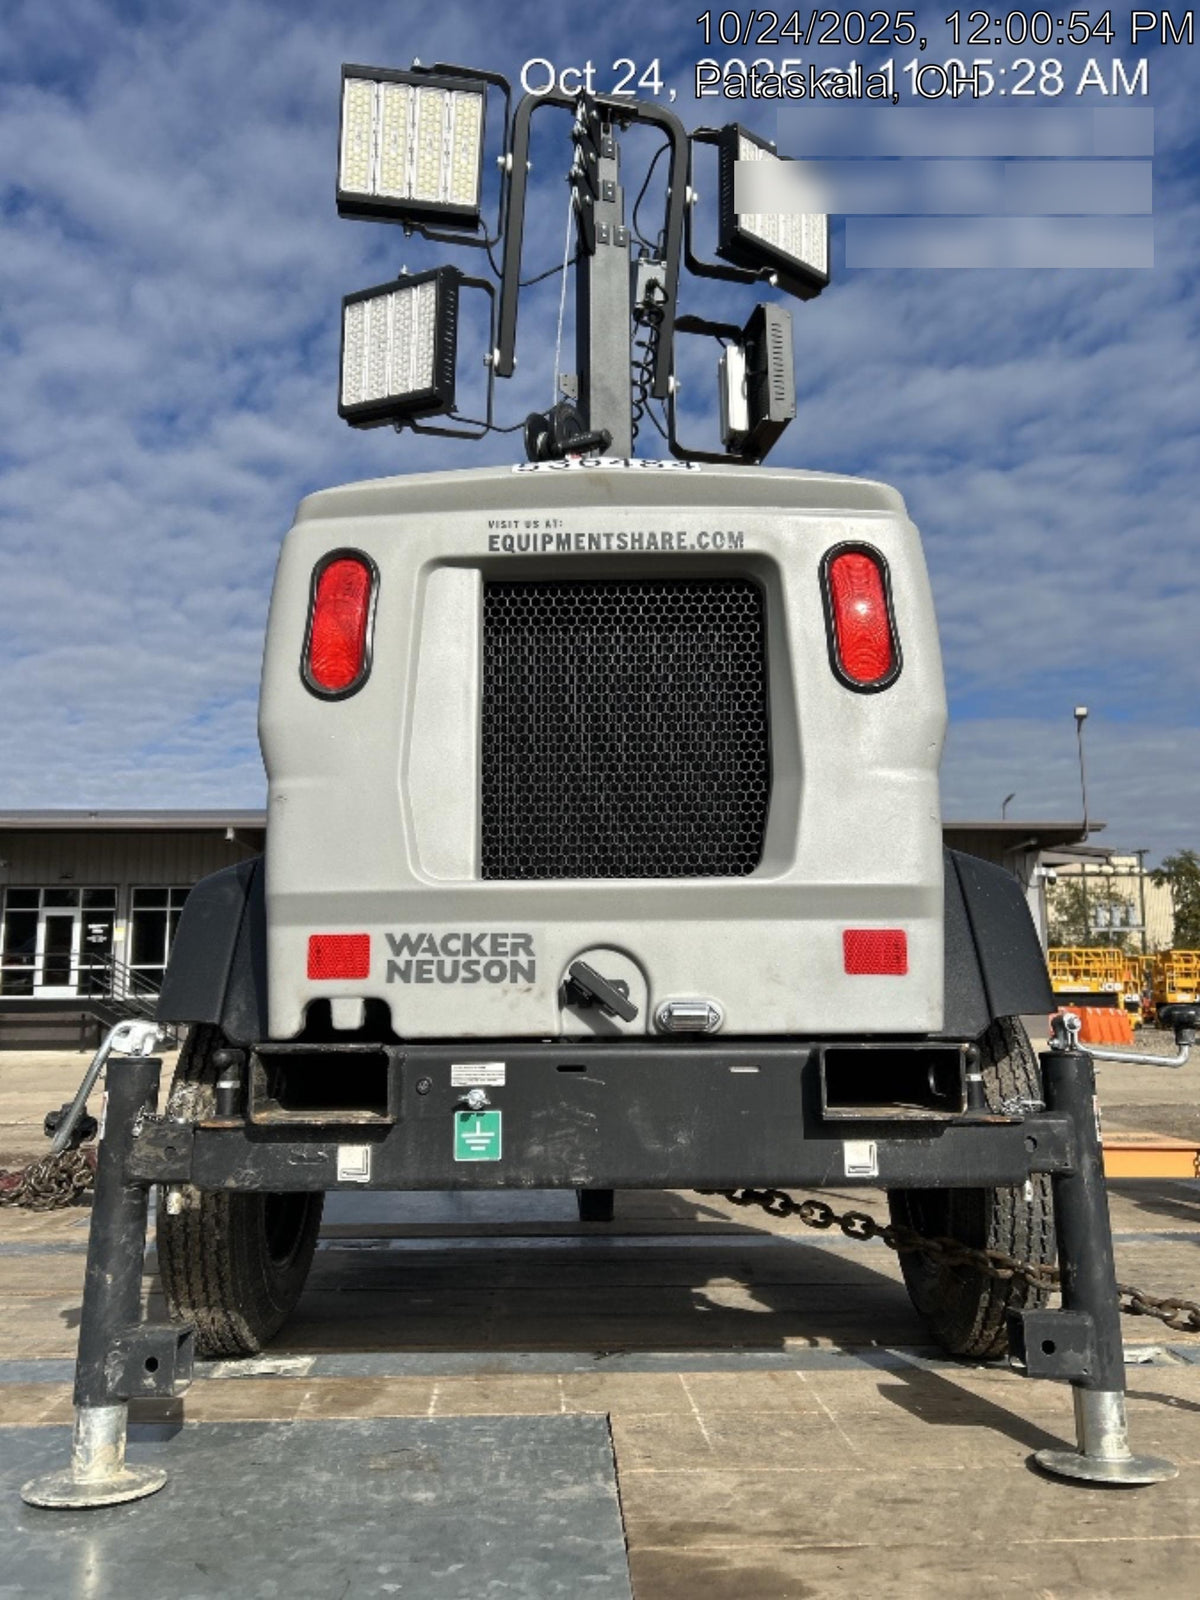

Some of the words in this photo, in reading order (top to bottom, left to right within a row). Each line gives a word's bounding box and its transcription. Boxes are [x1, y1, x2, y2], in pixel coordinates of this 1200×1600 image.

[488, 520, 519, 529] VISIT
[525, 520, 540, 529] US
[545, 519, 563, 529] AT:
[488, 531, 745, 554] EQUIPMENTSHARE.COM
[384, 932, 536, 957] WACKER
[385, 959, 536, 984] NEUSON
